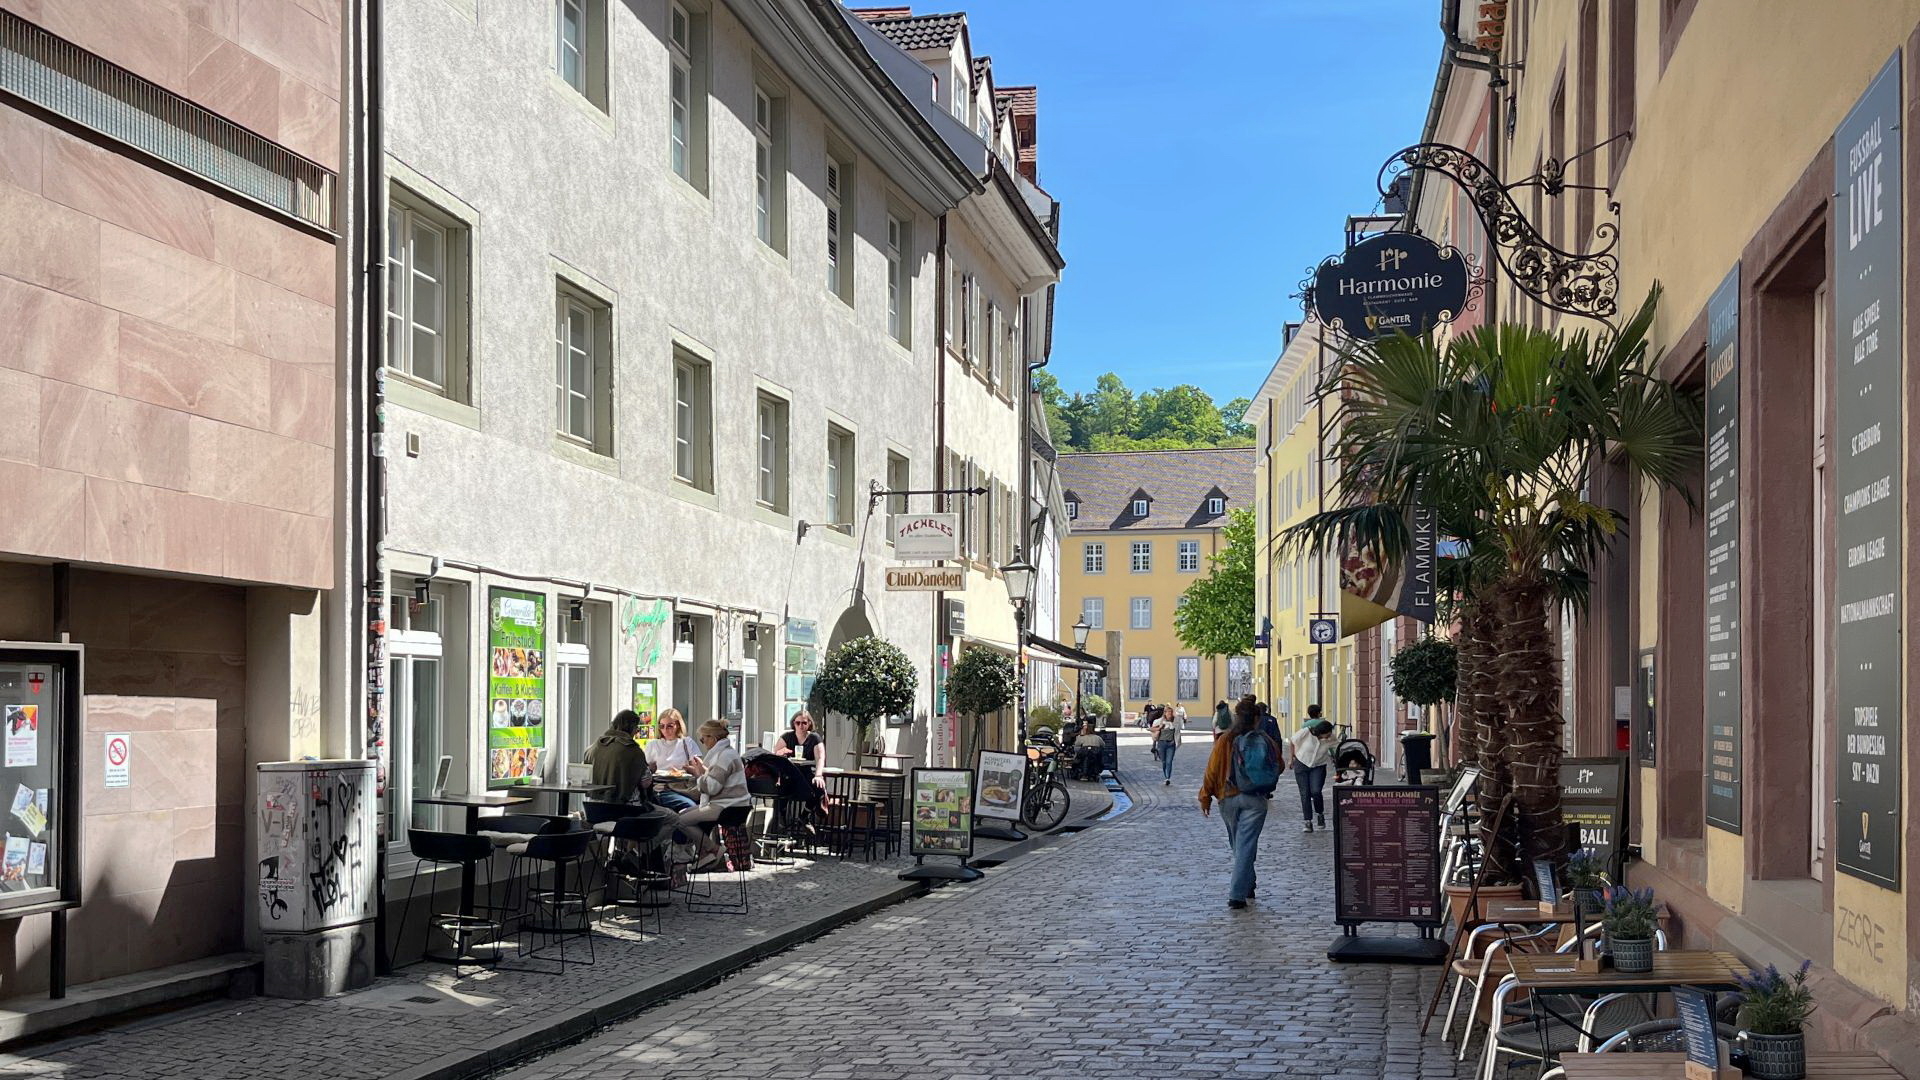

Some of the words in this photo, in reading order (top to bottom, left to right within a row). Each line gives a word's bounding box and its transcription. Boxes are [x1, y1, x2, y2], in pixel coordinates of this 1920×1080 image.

[1849, 116, 1882, 177] FUSSBALL
[1849, 152, 1883, 251] LIVE
[1339, 272, 1443, 296] Harmonie
[1378, 314, 1411, 325] GANTER
[1852, 312, 1864, 339] ALLE
[1864, 298, 1880, 330] SPIELE
[1853, 339, 1865, 366] ALLE
[1866, 328, 1879, 357] TORE
[1710, 341, 1734, 390] KLASSIKER
[1851, 434, 1858, 457] SC
[1858, 421, 1881, 454] FREIBURG
[1843, 484, 1871, 515] CHAMPIONS
[1871, 475, 1890, 503] LEAGUE
[899, 518, 953, 538] TACHELES
[1848, 543, 1866, 568] EUROPA
[1866, 536, 1885, 562] LEAGUE
[1840, 592, 1895, 624] NATIONALMANNSCHAFT
[501, 631, 536, 648] Frühstück
[494, 683, 512, 695] Kaffee
[515, 683, 520, 695] &
[1854, 706, 1878, 727] TOPSPIELE
[936, 723, 944, 751] Studio
[1847, 734, 1856, 754] DER
[1856, 734, 1886, 756] BUNDESLIGA
[1852, 761, 1862, 782] SKY
[1866, 763, 1880, 784] DAZN
[1395, 790, 1420, 798] FLAMBÉE
[1564, 785, 1603, 794] Harmonie
[1580, 828, 1609, 845] BALL
